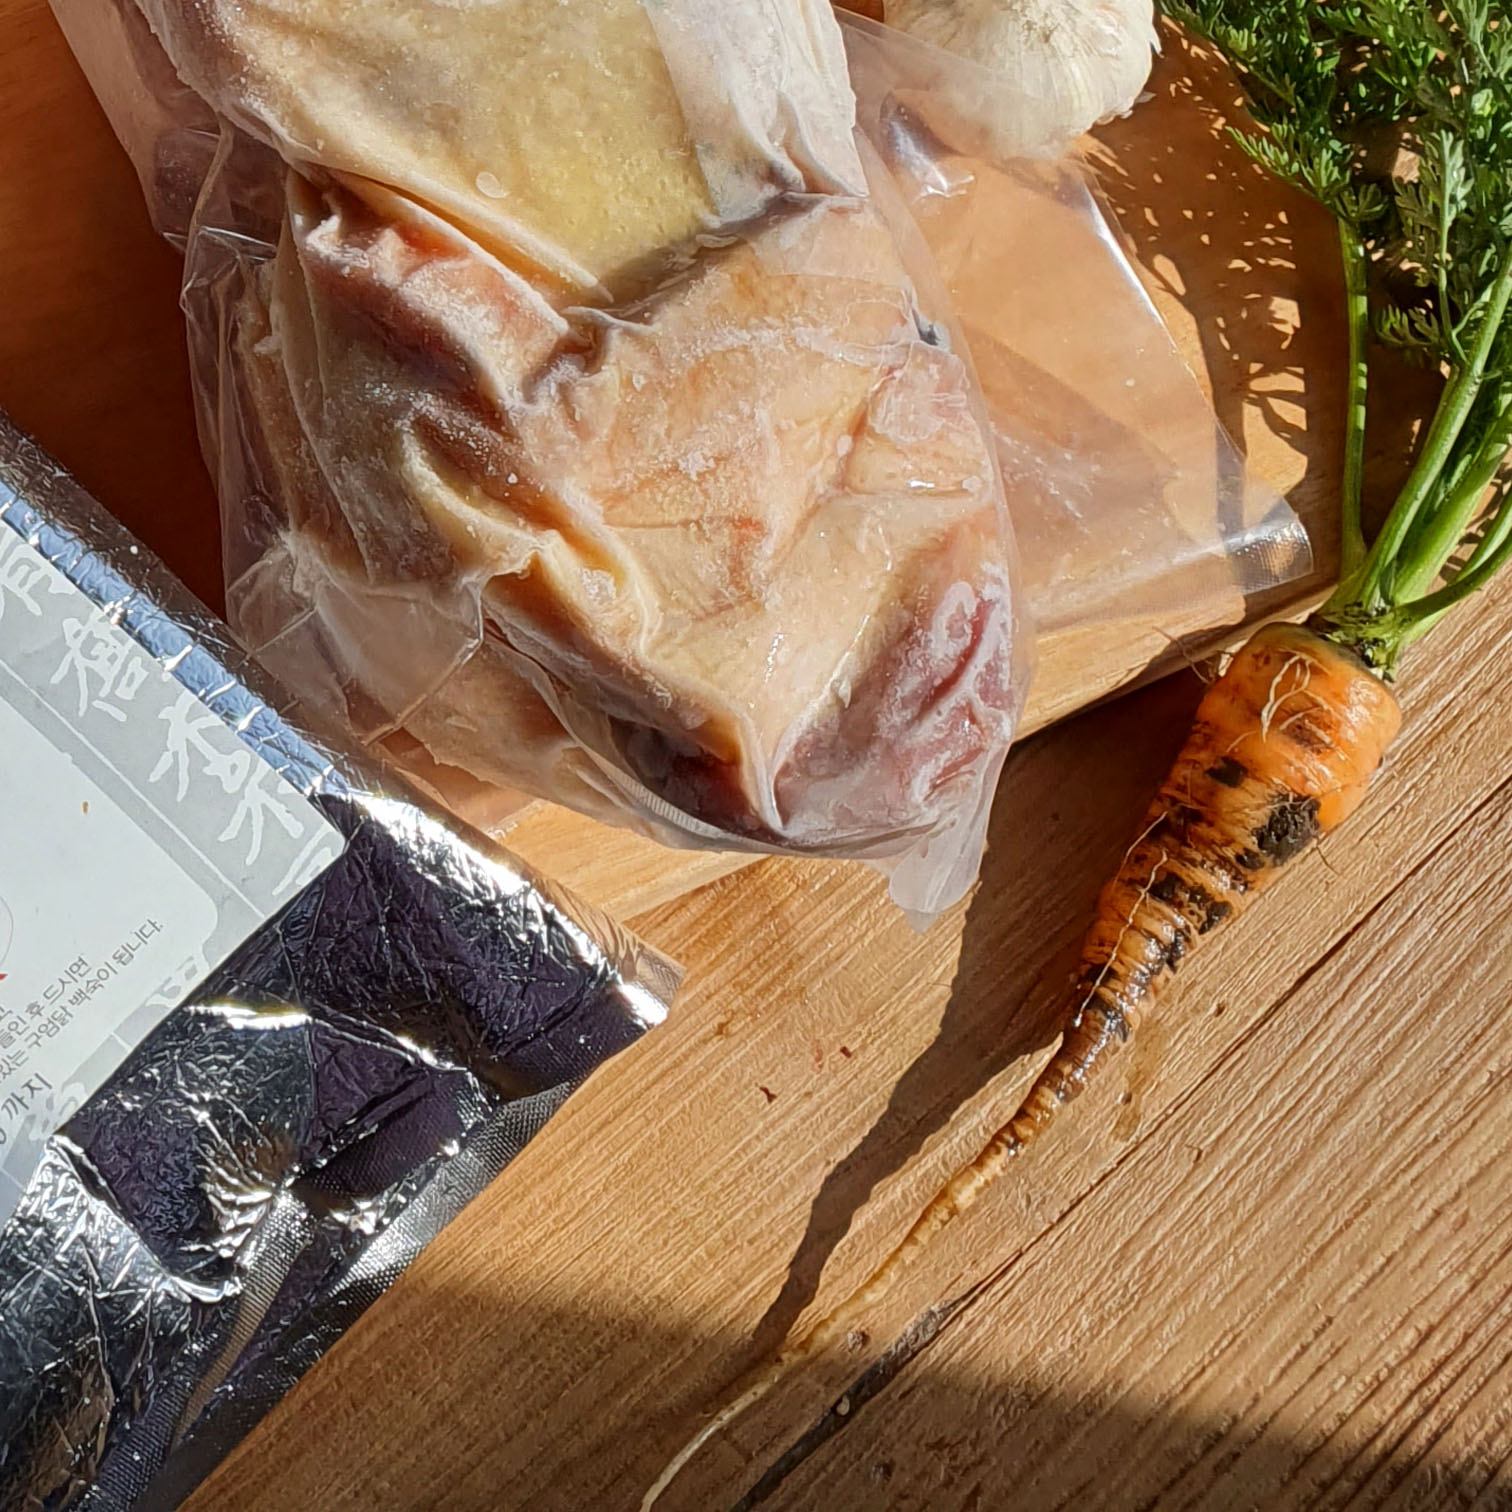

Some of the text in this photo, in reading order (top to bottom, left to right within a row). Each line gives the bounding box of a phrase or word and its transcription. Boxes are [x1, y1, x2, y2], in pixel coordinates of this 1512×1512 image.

[23, 997, 74, 1049] 구엄닭
[67, 960, 118, 1006] 백숙이
[111, 918, 164, 966] 됩니다.
[24, 1000, 45, 1020] 후
[42, 955, 92, 1005] 드시면
[1, 1073, 52, 1121] 까지
